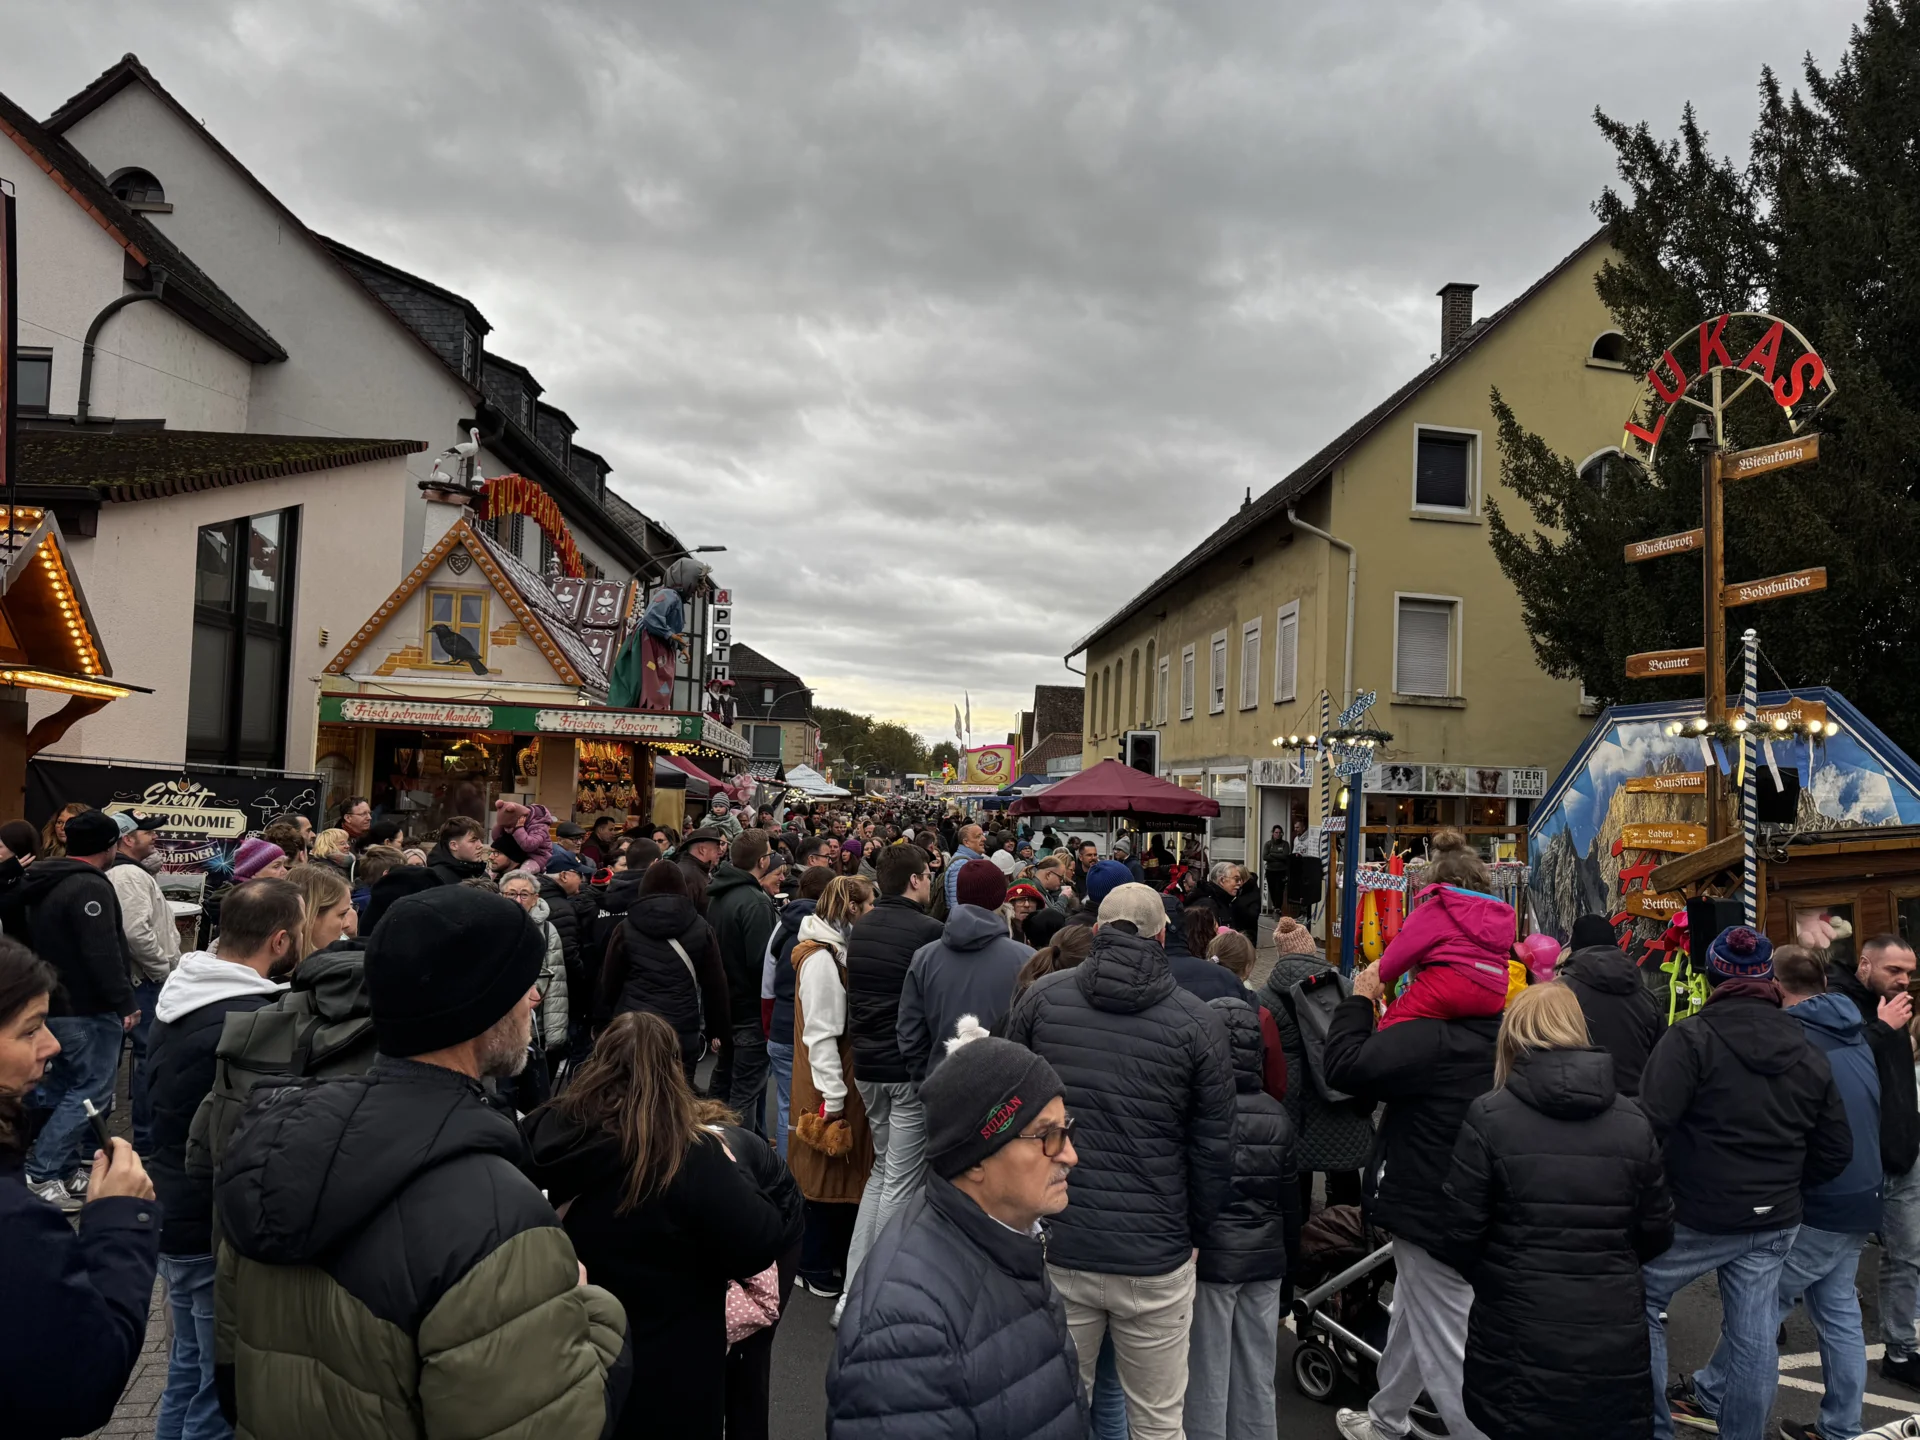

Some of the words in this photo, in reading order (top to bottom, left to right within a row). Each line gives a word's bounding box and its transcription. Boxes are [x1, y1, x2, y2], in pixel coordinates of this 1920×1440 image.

[1624, 314, 1824, 444] LUKAS
[1739, 446, 1803, 471] Wiesnkönig
[1636, 535, 1693, 556] Muskelprotz
[1740, 575, 1810, 600] Bodybuilder
[1649, 656, 1689, 671] Beamter
[353, 704, 388, 719] Frisch
[392, 708, 442, 720] gebrannte
[443, 709, 481, 723] Mandeln
[559, 715, 605, 729] Frisches
[613, 718, 658, 732] Popcorn
[1513, 771, 1539, 779] TIER
[1653, 775, 1700, 789] Hausfrau
[141, 780, 215, 809] Event
[1648, 829, 1673, 838] Ladies
[981, 1096, 1023, 1140] SULTAN
